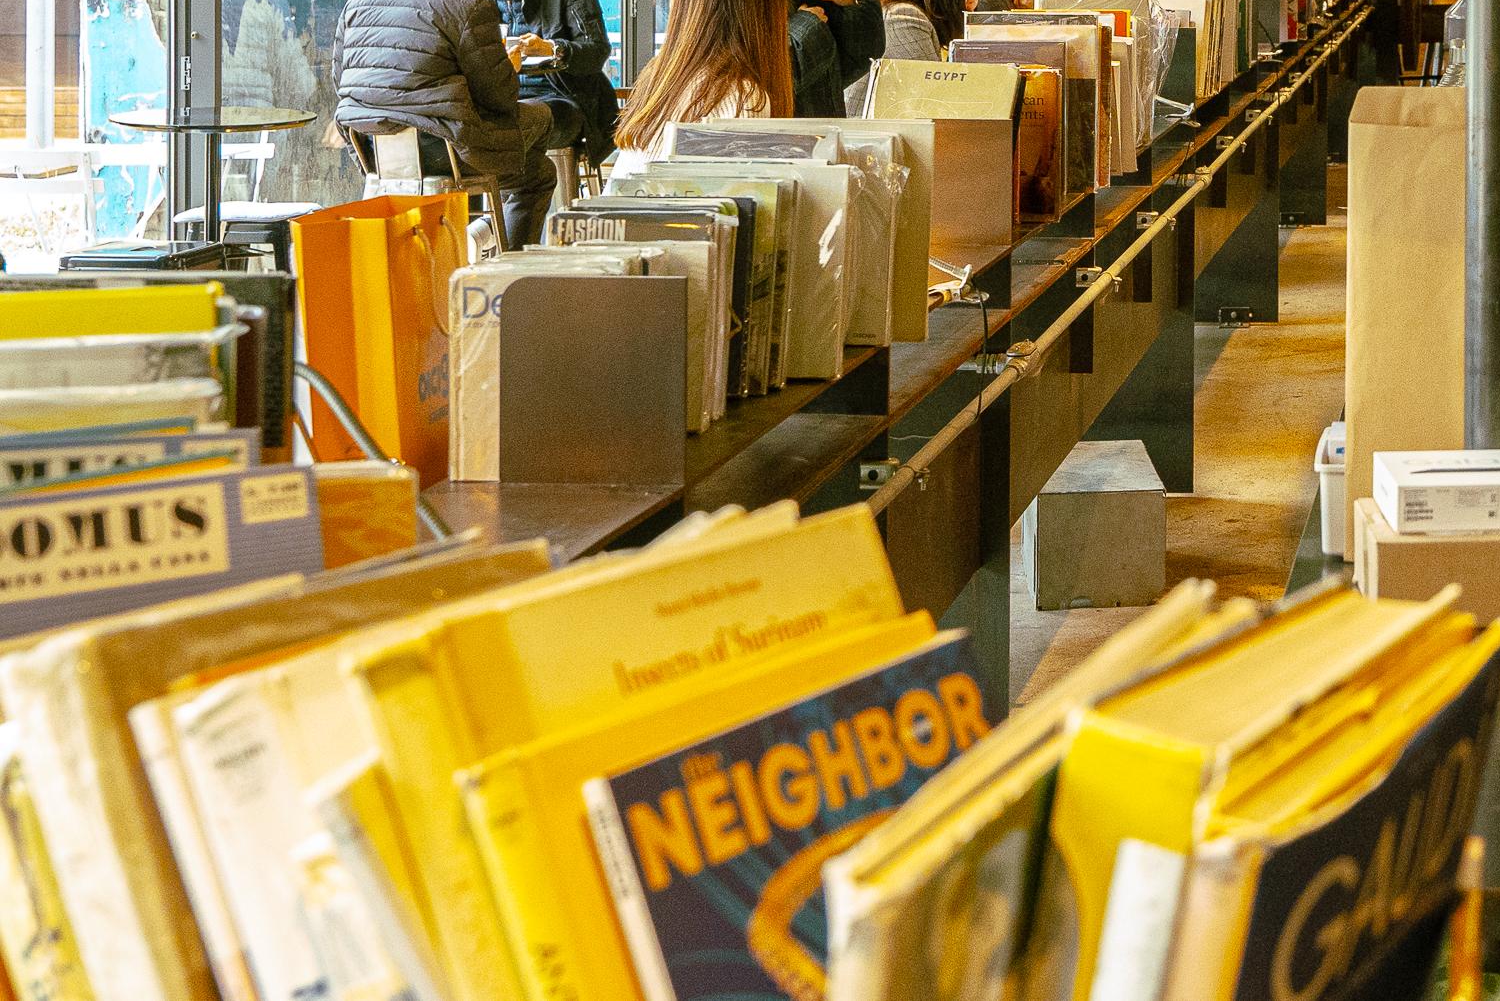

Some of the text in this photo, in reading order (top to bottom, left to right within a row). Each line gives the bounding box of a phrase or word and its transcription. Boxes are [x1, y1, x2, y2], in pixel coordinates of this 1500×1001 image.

[924, 71, 967, 82] EGYPT
[557, 219, 626, 243] FASHION
[0, 498, 207, 558] OMUS
[626, 671, 993, 892] NEIGHBOR
